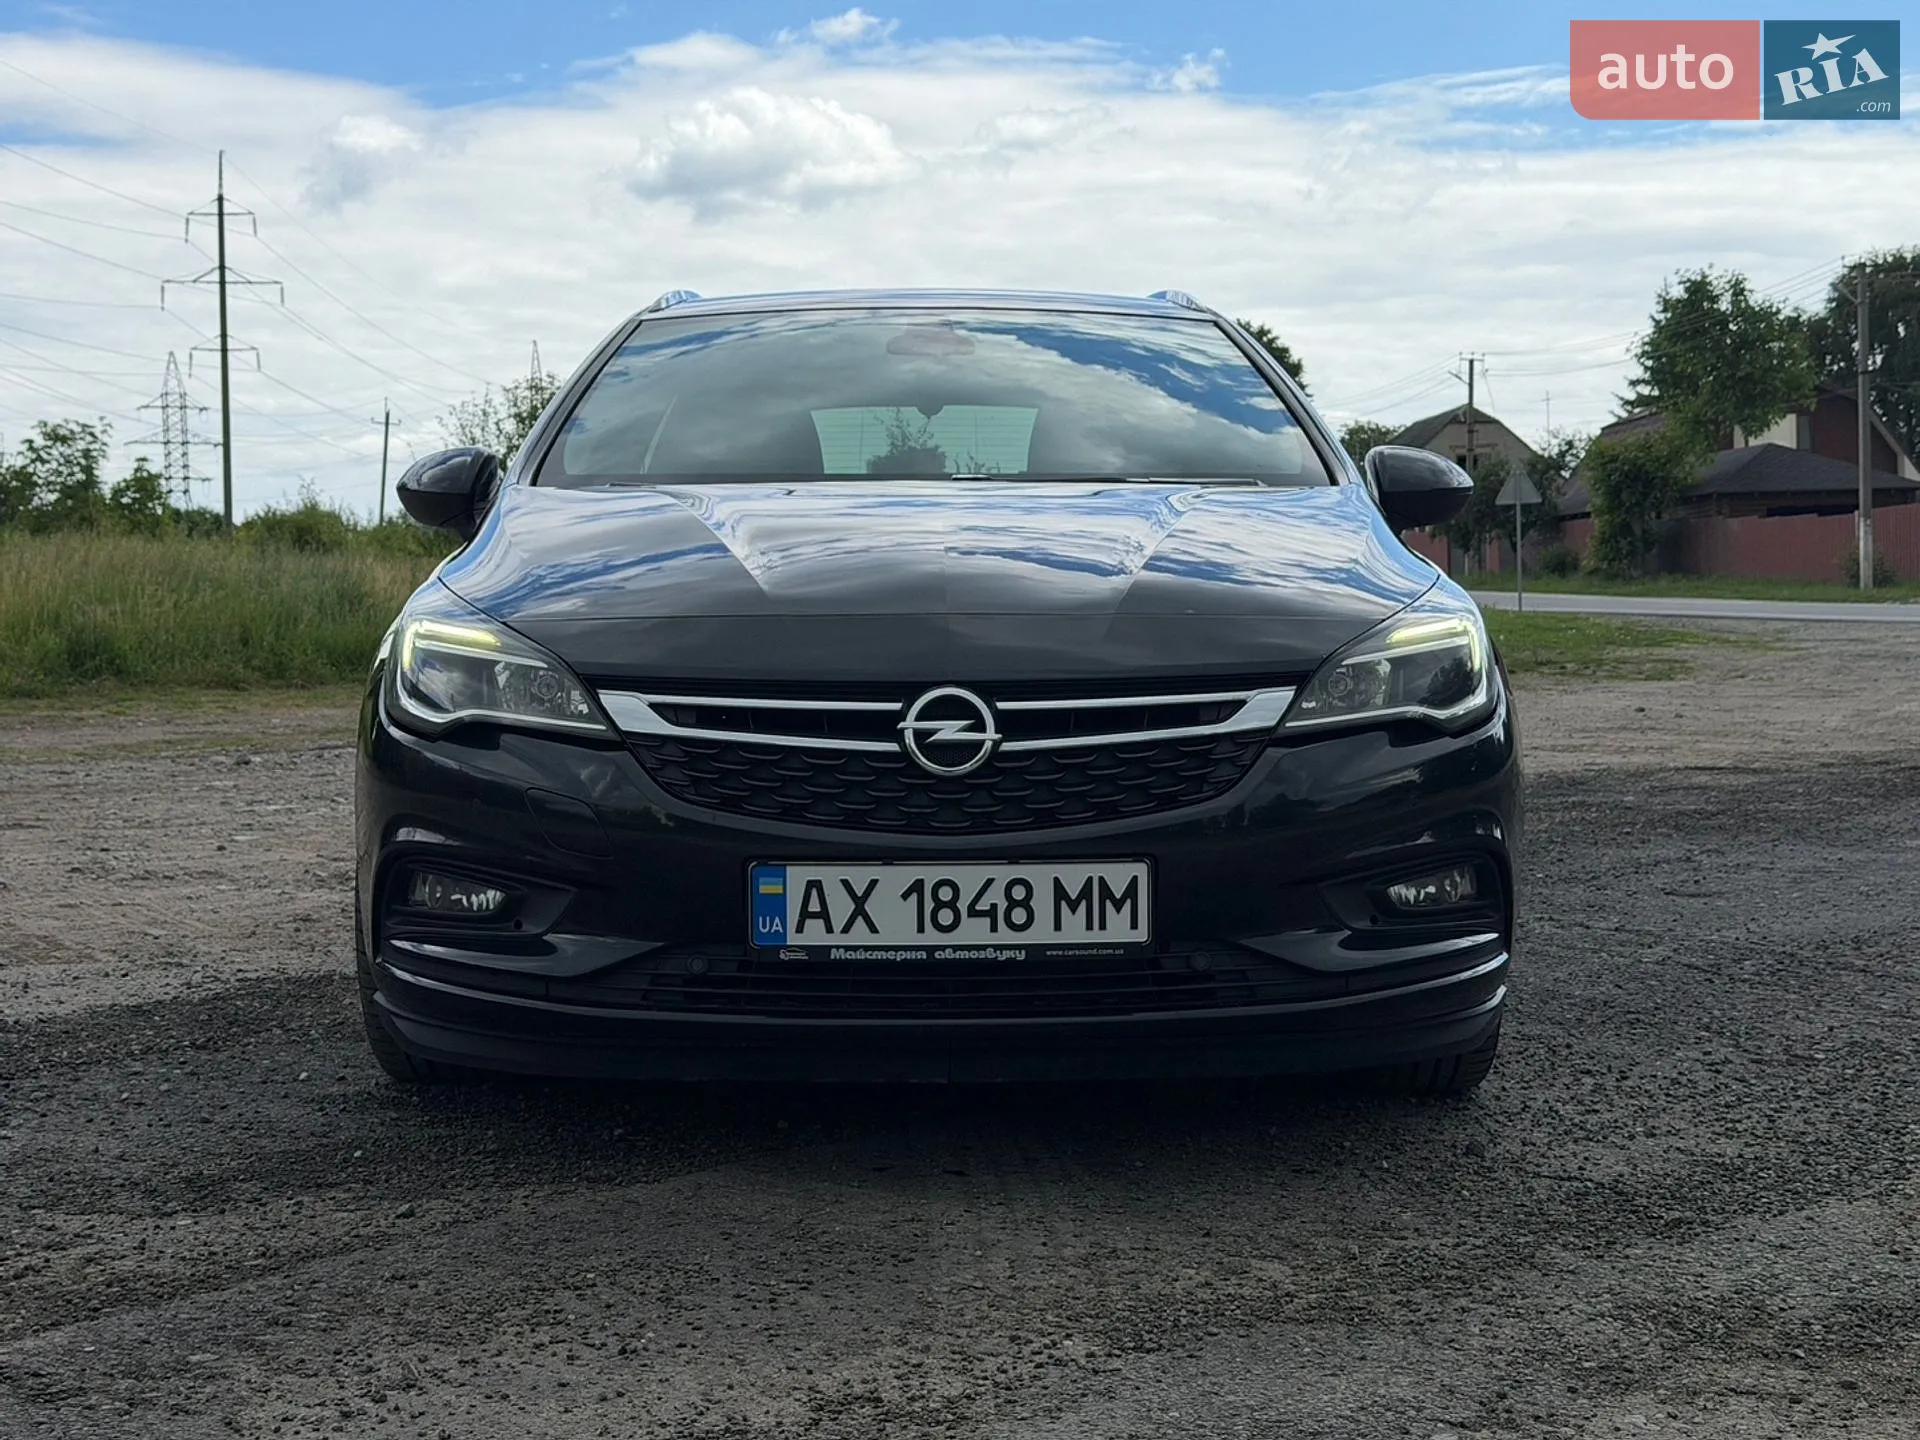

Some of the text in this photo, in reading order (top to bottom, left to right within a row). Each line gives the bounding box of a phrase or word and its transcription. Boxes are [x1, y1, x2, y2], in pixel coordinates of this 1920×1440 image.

[795, 874, 1139, 934] AX 1848 MM
[758, 917, 784, 934] UA
